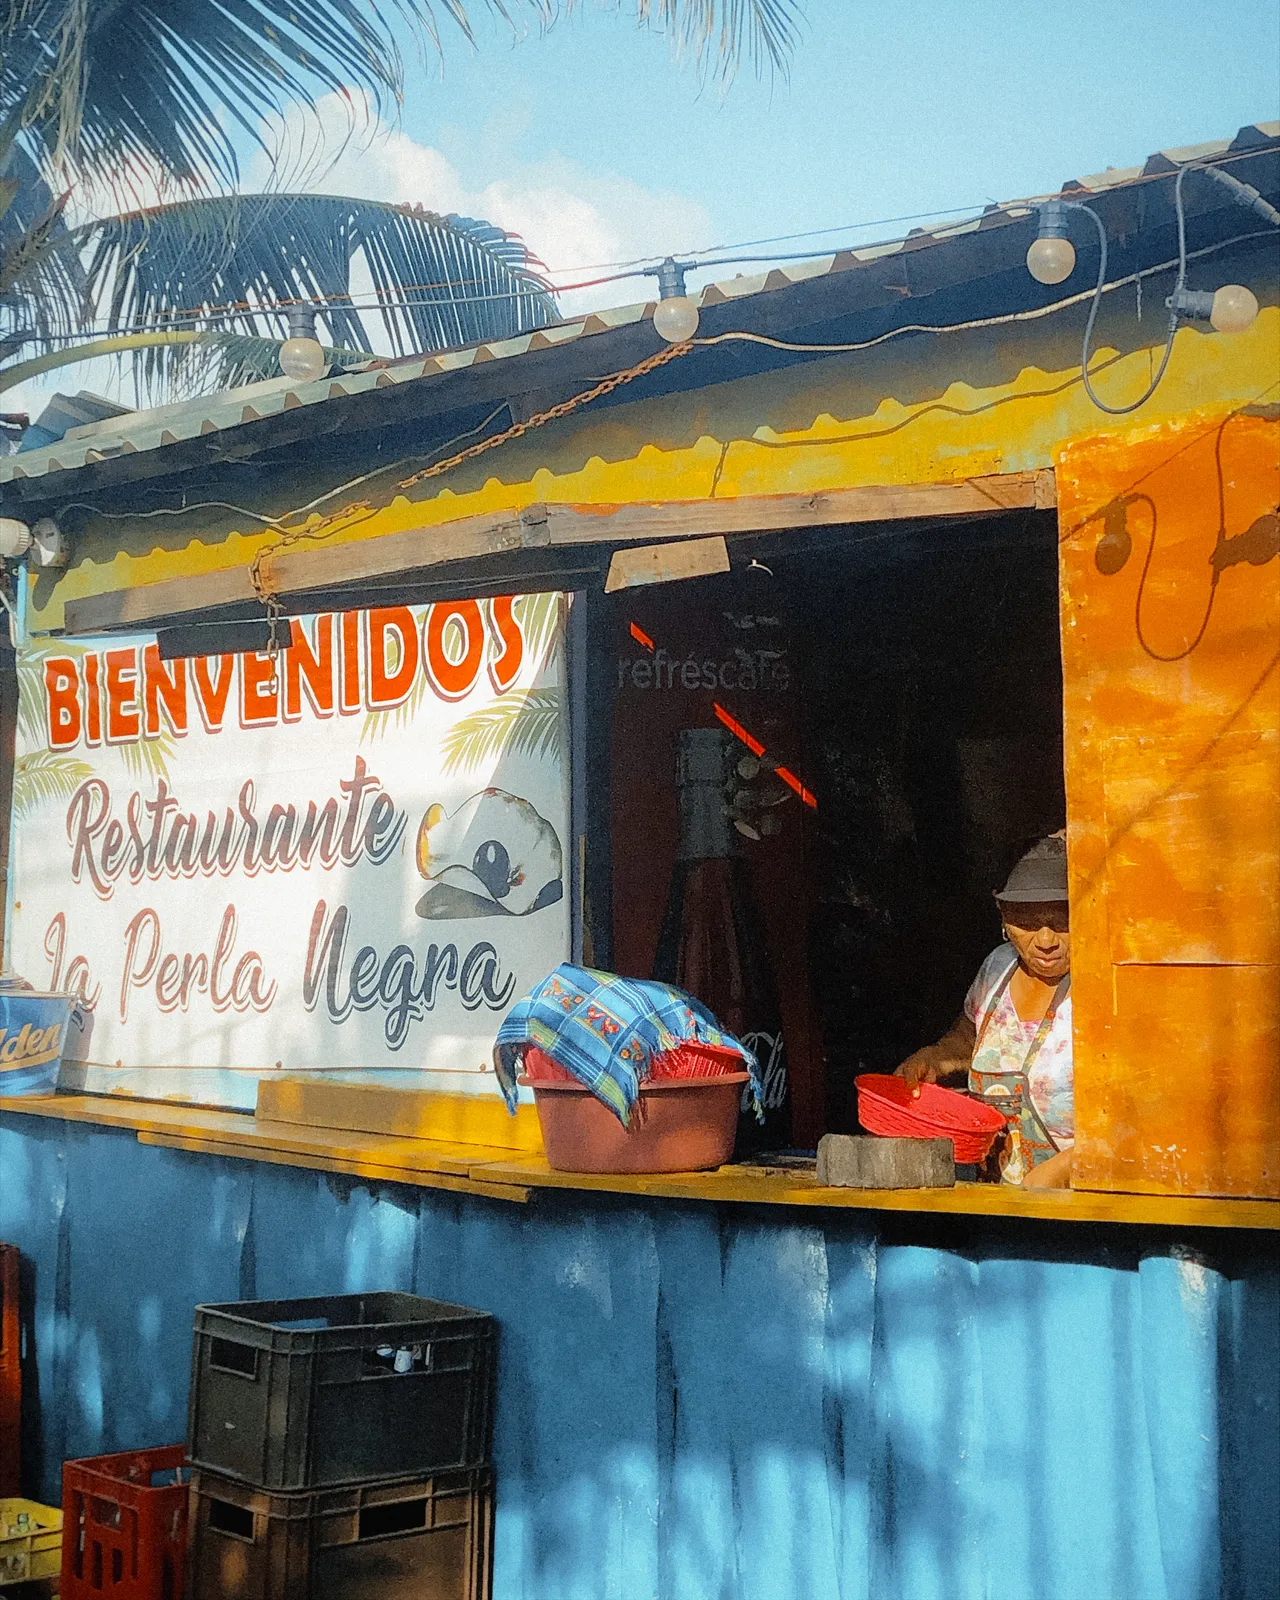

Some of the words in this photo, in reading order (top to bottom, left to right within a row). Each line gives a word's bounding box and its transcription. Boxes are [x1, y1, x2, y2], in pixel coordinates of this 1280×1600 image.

[43, 594, 526, 751] BIENVENIDOS
[67, 755, 407, 900] Restaurante
[120, 903, 279, 1024] Perla
[302, 898, 518, 1051] Negra
